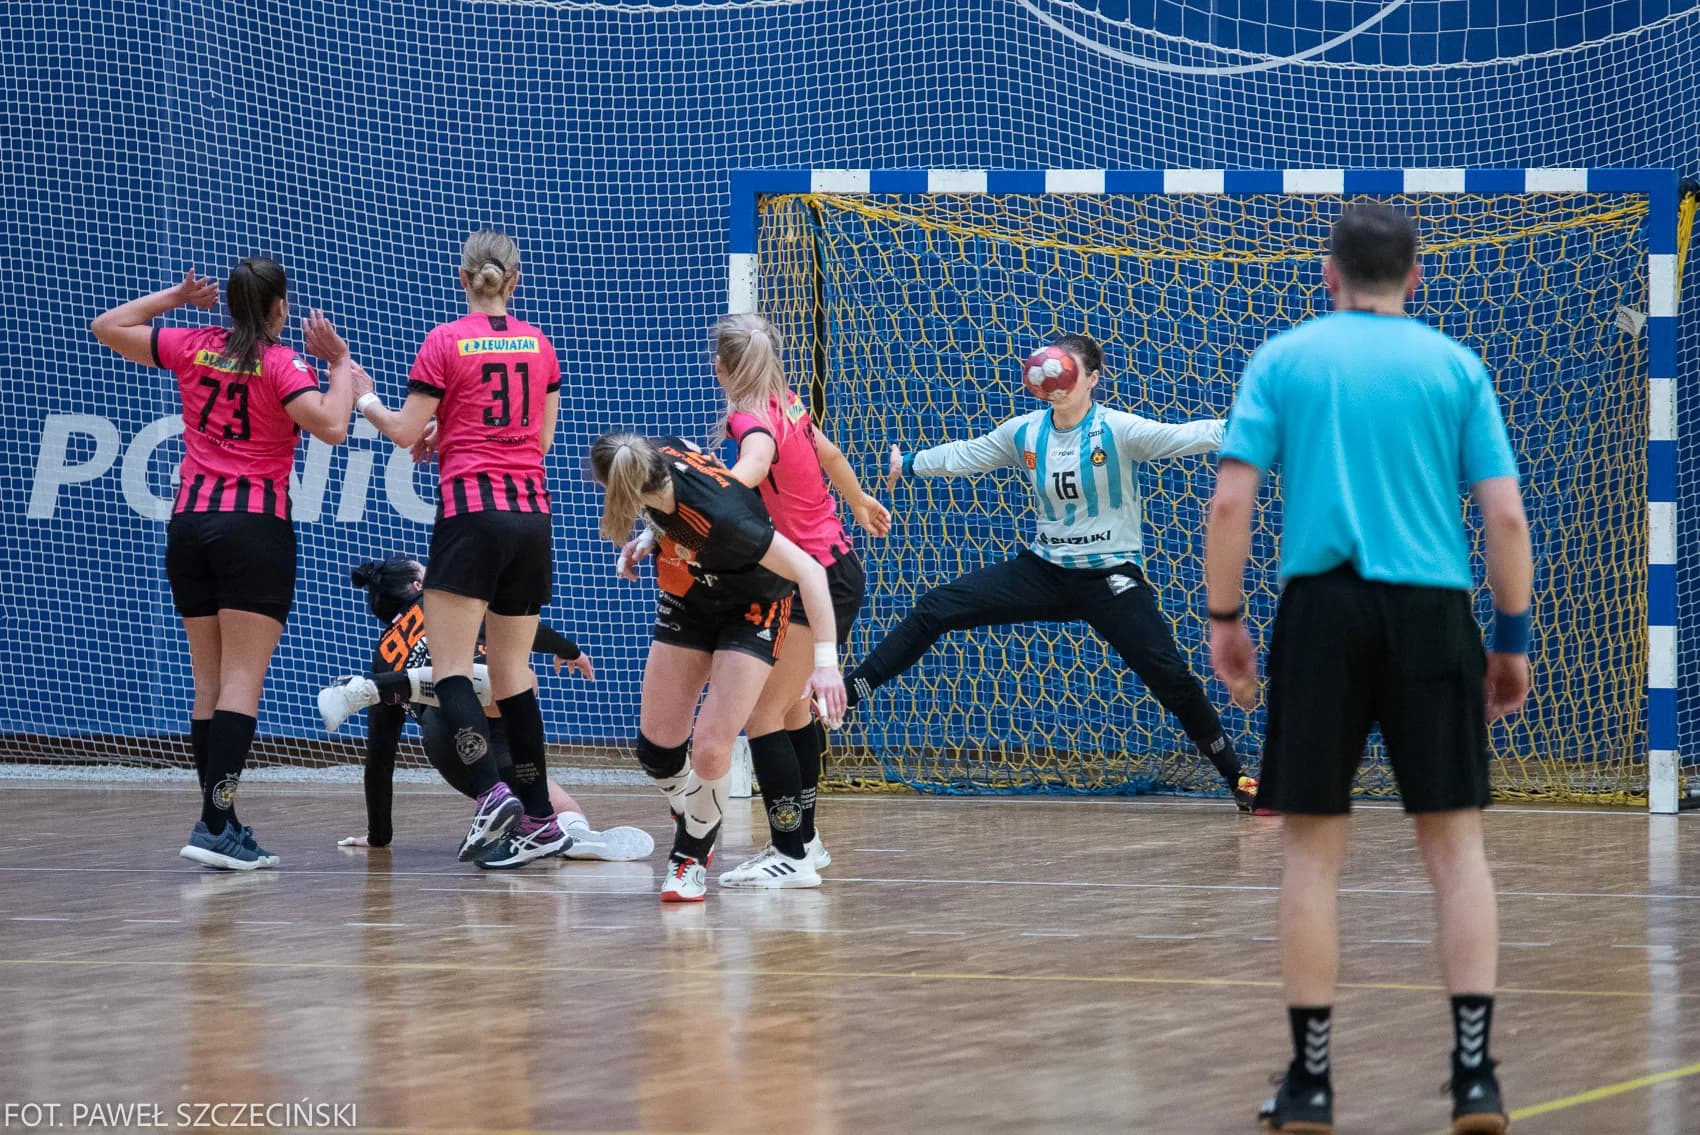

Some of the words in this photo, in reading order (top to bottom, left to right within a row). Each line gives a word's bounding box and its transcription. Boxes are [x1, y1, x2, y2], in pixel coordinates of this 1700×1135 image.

[481, 339, 535, 352] LEWIATAN
[198, 375, 251, 440] 73
[481, 362, 530, 427] 31
[1053, 471, 1079, 501] 16
[1050, 530, 1111, 545] SUZUKI
[379, 604, 426, 672] 92
